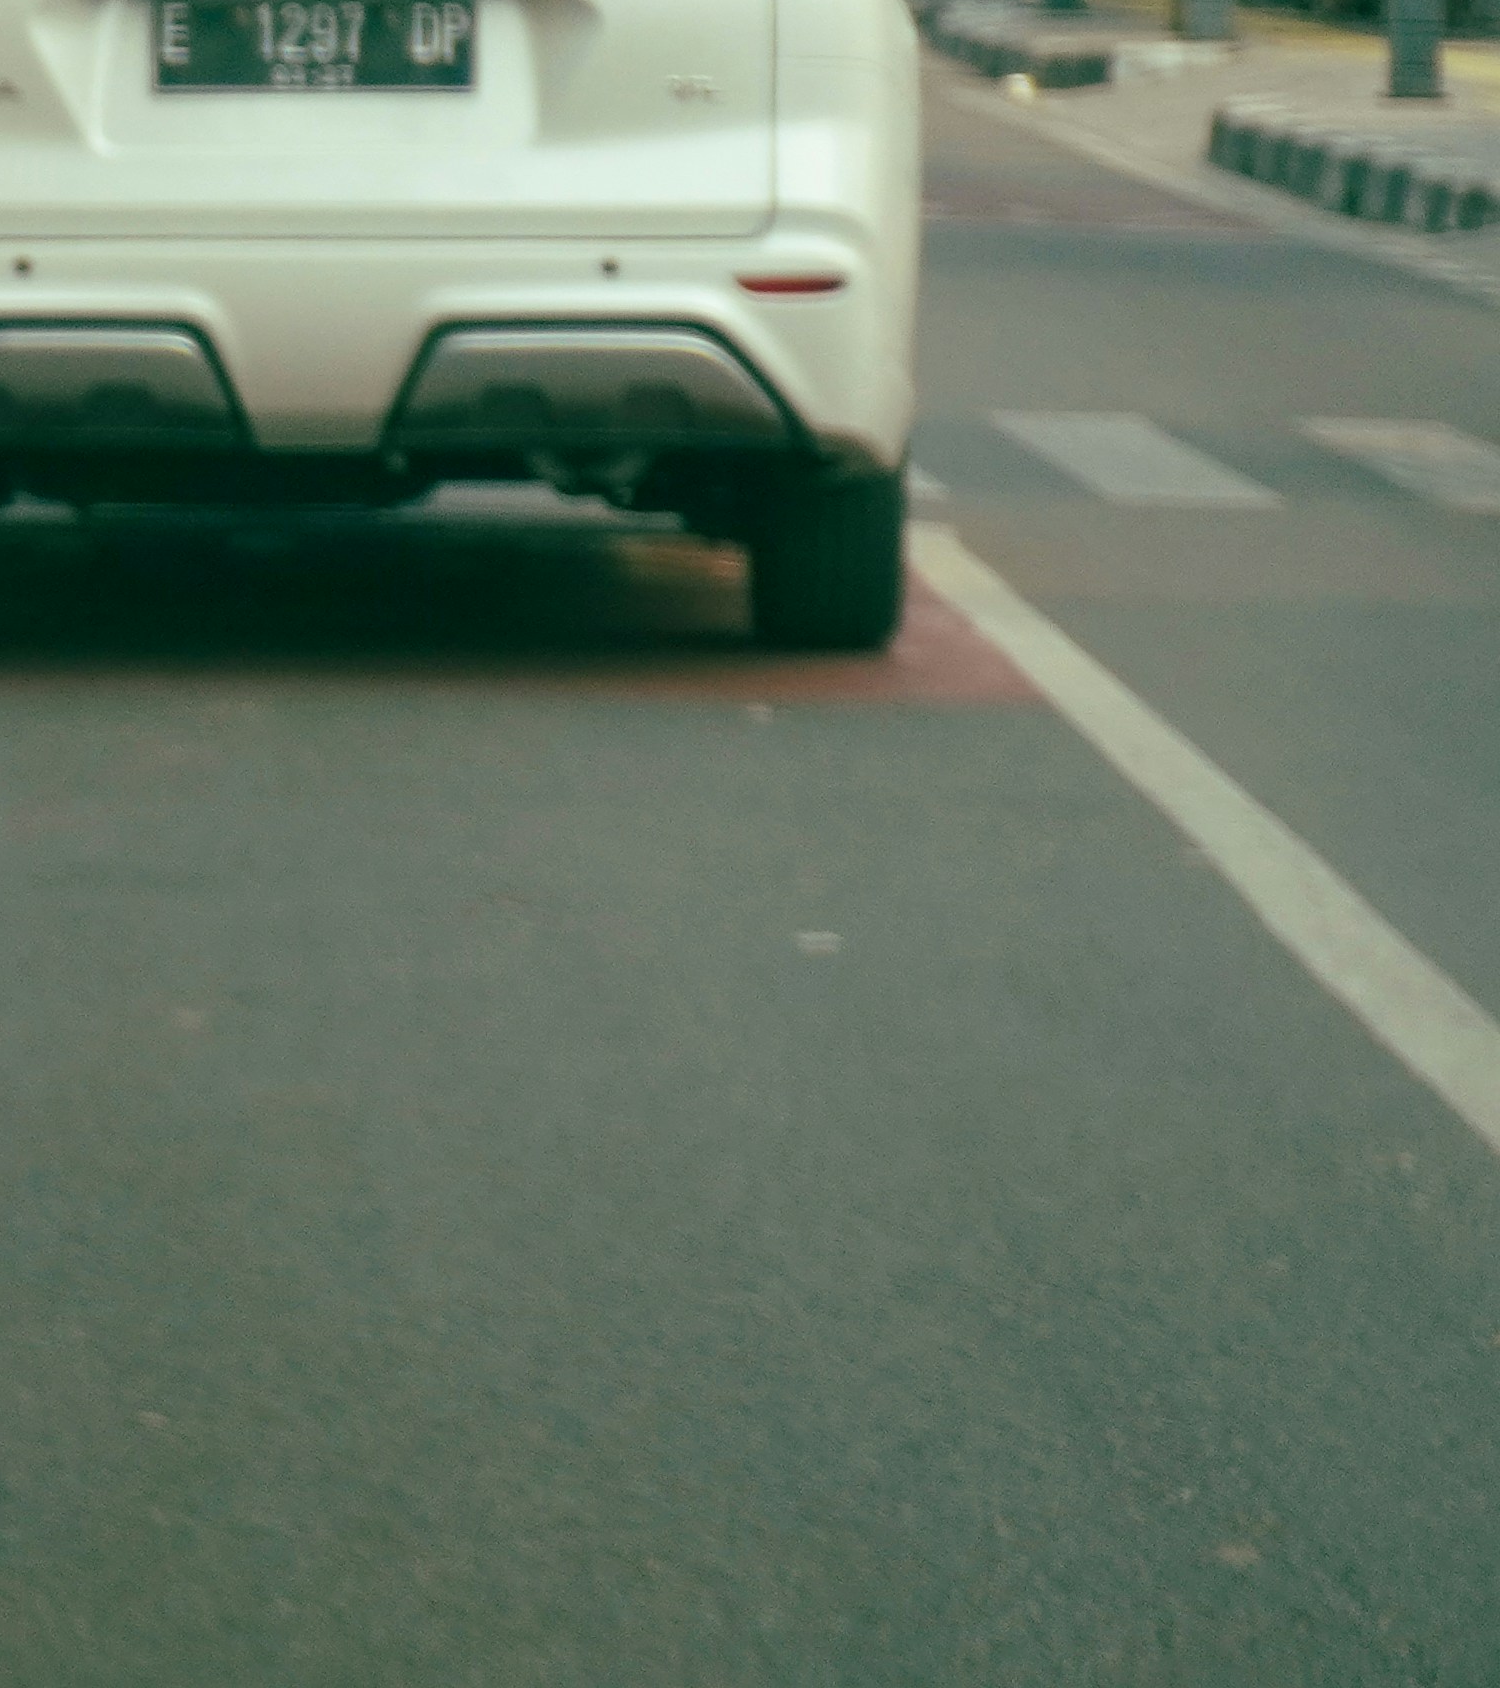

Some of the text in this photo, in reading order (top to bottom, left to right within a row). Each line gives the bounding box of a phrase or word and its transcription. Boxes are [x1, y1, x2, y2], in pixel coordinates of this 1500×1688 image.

[163, 1, 473, 65] E 1297 DP
